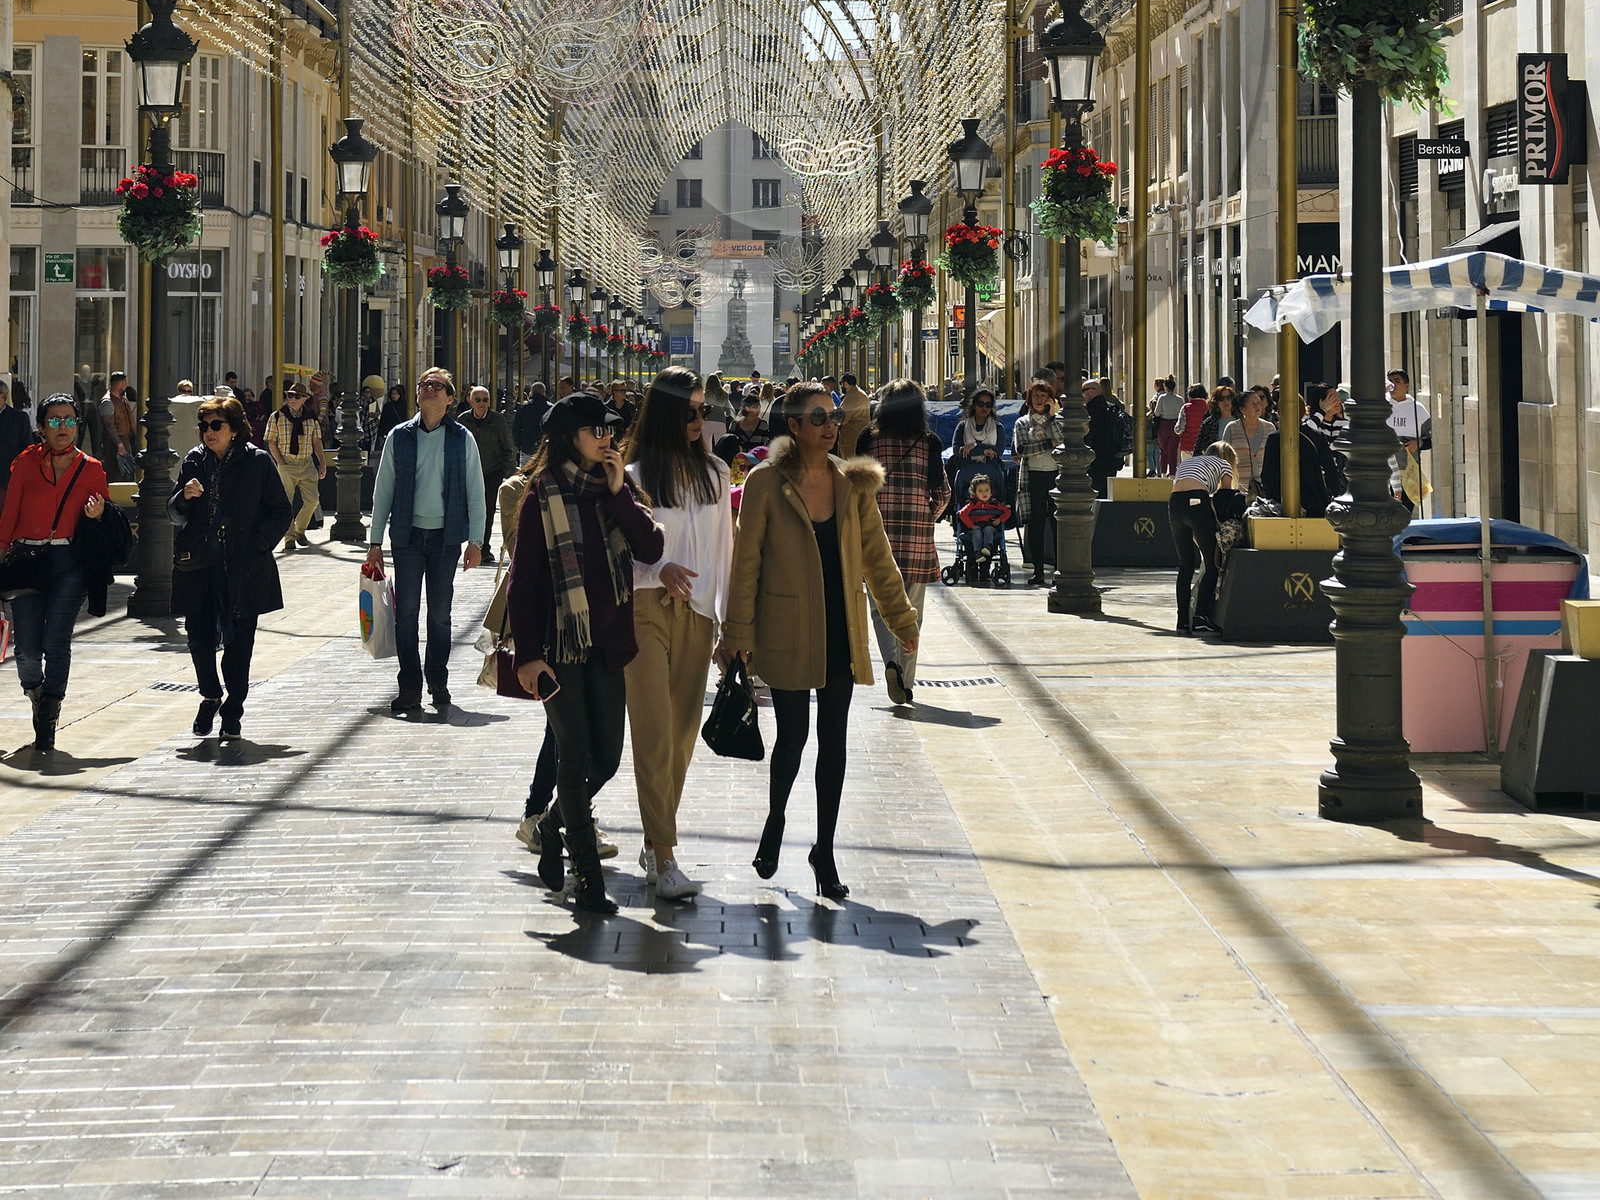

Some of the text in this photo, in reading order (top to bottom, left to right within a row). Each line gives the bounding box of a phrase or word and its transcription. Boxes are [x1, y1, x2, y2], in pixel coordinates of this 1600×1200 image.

[1524, 61, 1547, 178] PRIMOR
[1418, 143, 1461, 155] Bershka
[167, 262, 212, 279] OYSHO
